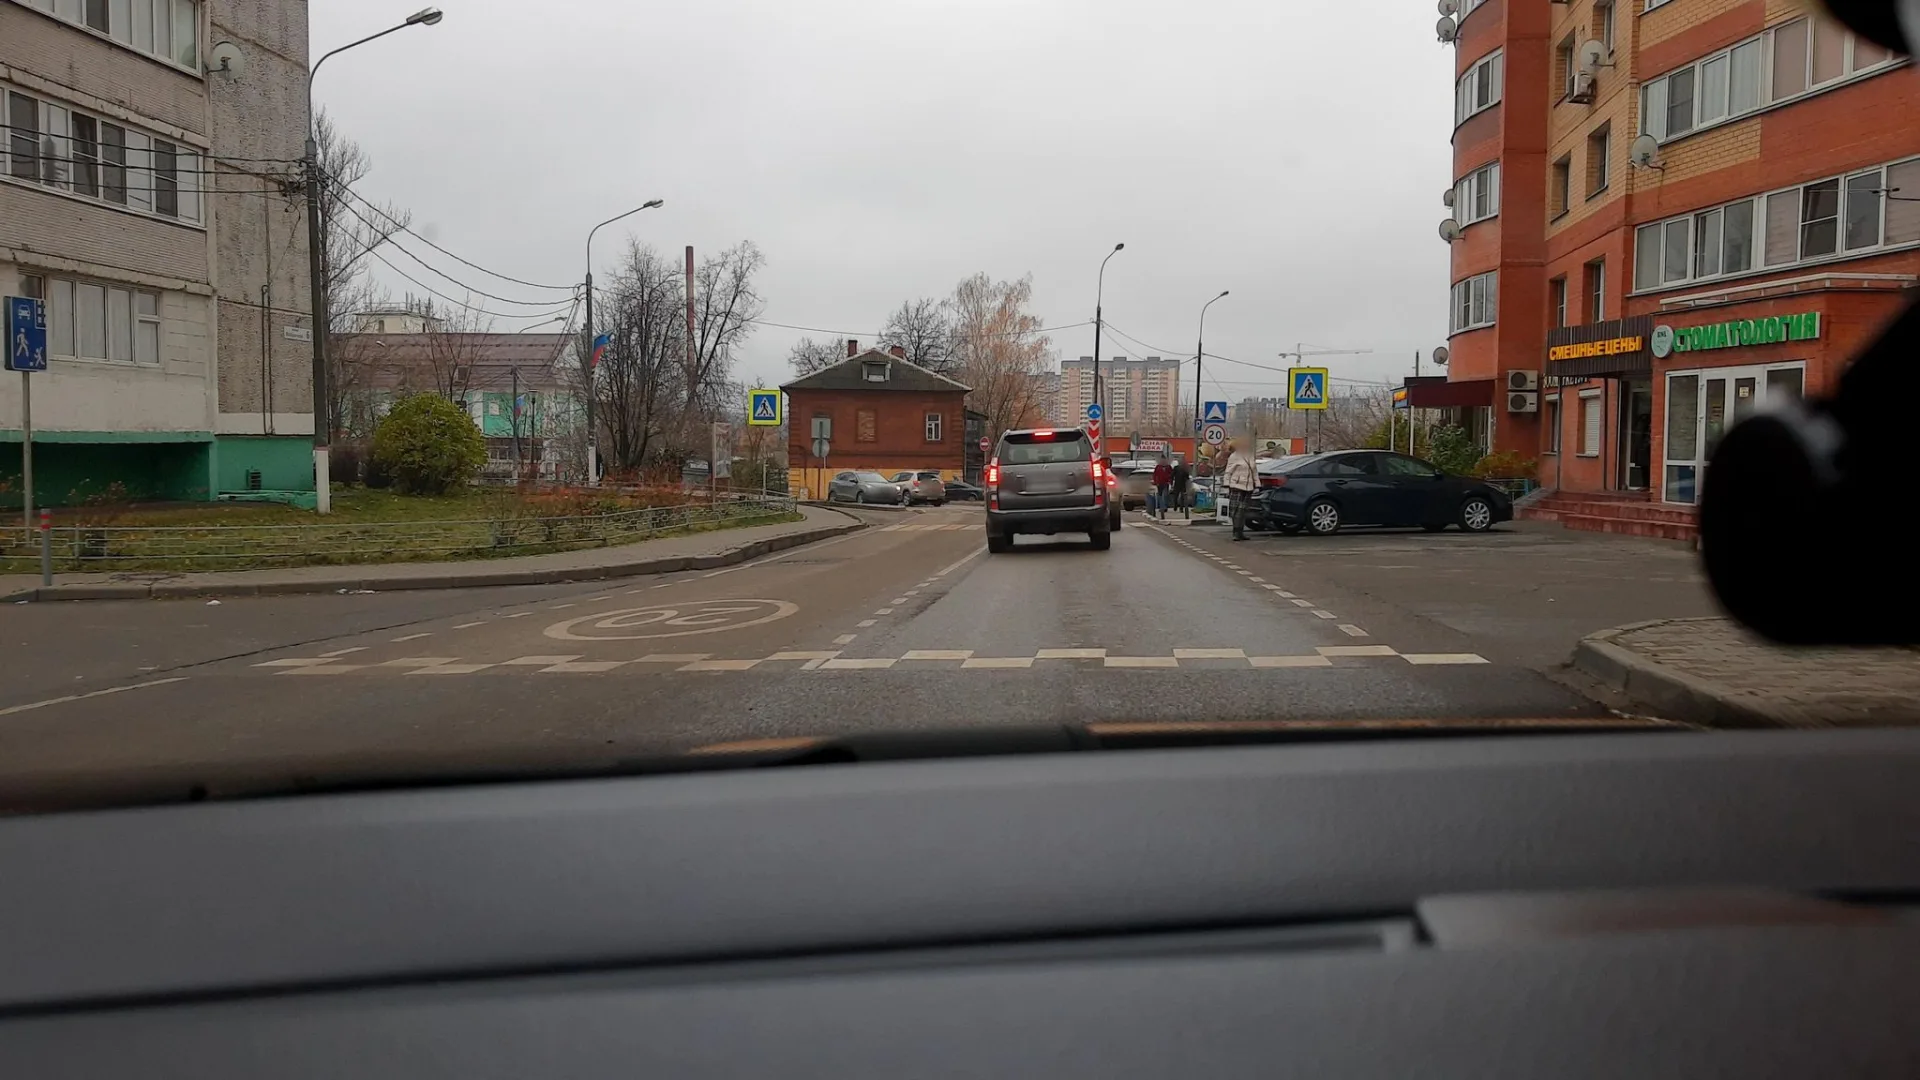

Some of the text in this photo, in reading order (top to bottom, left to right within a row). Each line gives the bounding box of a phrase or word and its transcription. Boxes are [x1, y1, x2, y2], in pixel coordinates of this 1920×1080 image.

[1673, 311, 1820, 353] СТОМАТОЛОГИЯ
[1549, 336, 1642, 361] СМЕШНЫЕ ЦЕНЫ
[1208, 430, 1222, 440] 20
